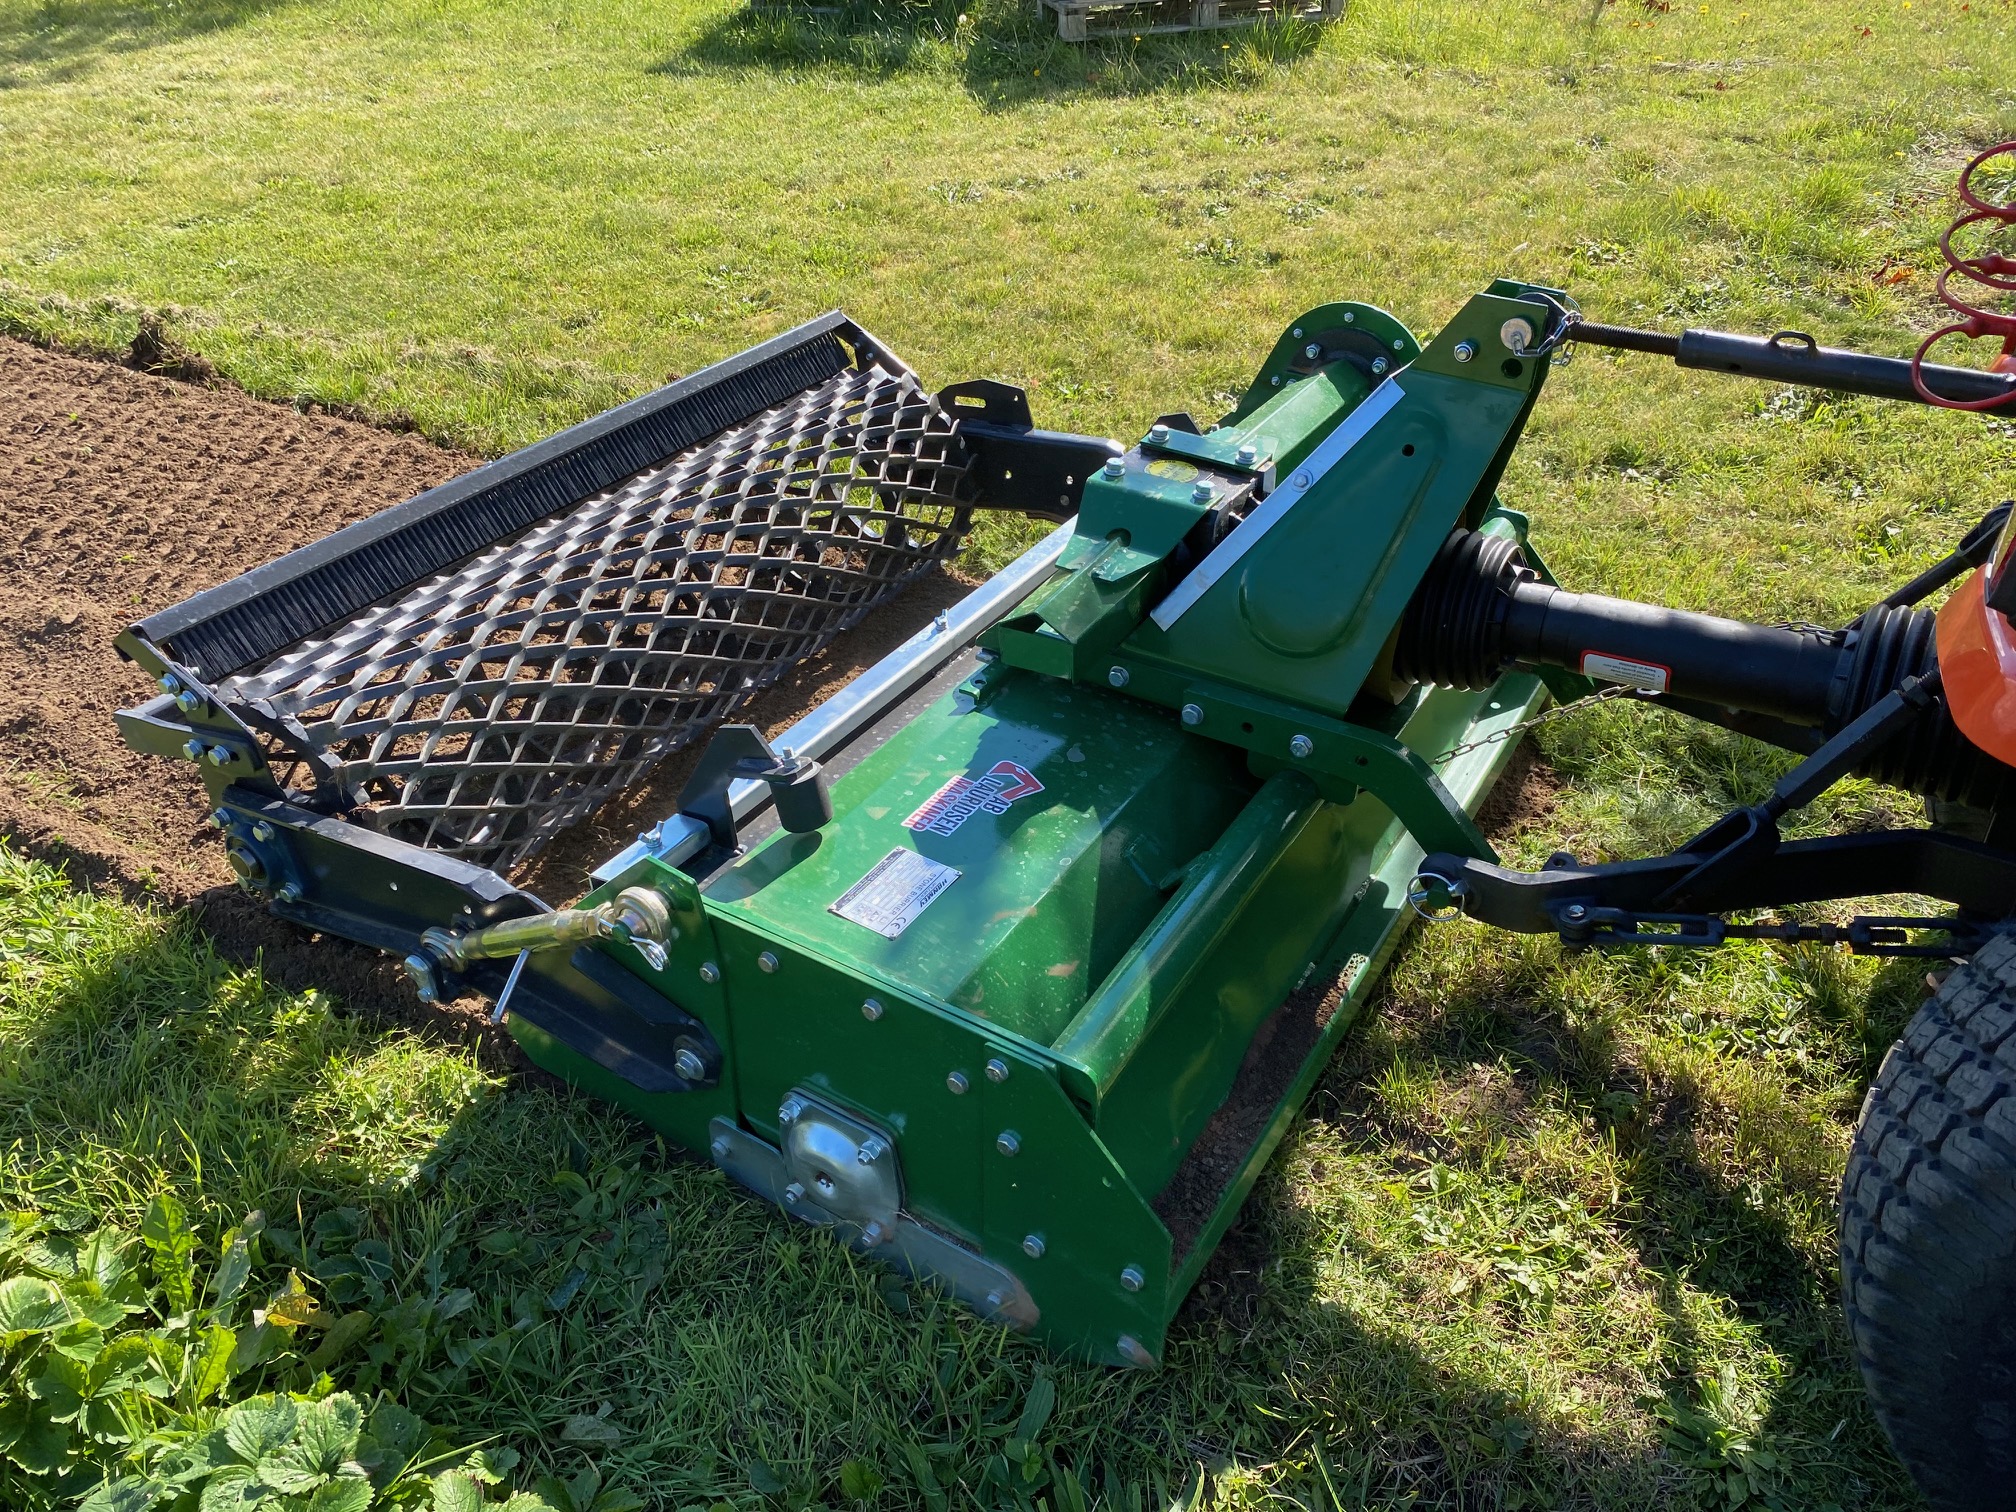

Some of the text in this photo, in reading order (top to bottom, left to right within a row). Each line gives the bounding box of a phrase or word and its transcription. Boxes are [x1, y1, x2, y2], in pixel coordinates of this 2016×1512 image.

[904, 776, 974, 830] MASKINER
[930, 777, 1002, 835] LAURIDSEN
[982, 796, 1011, 815] AB
[915, 873, 936, 892] STONE
[891, 890, 918, 916] BURRIER
